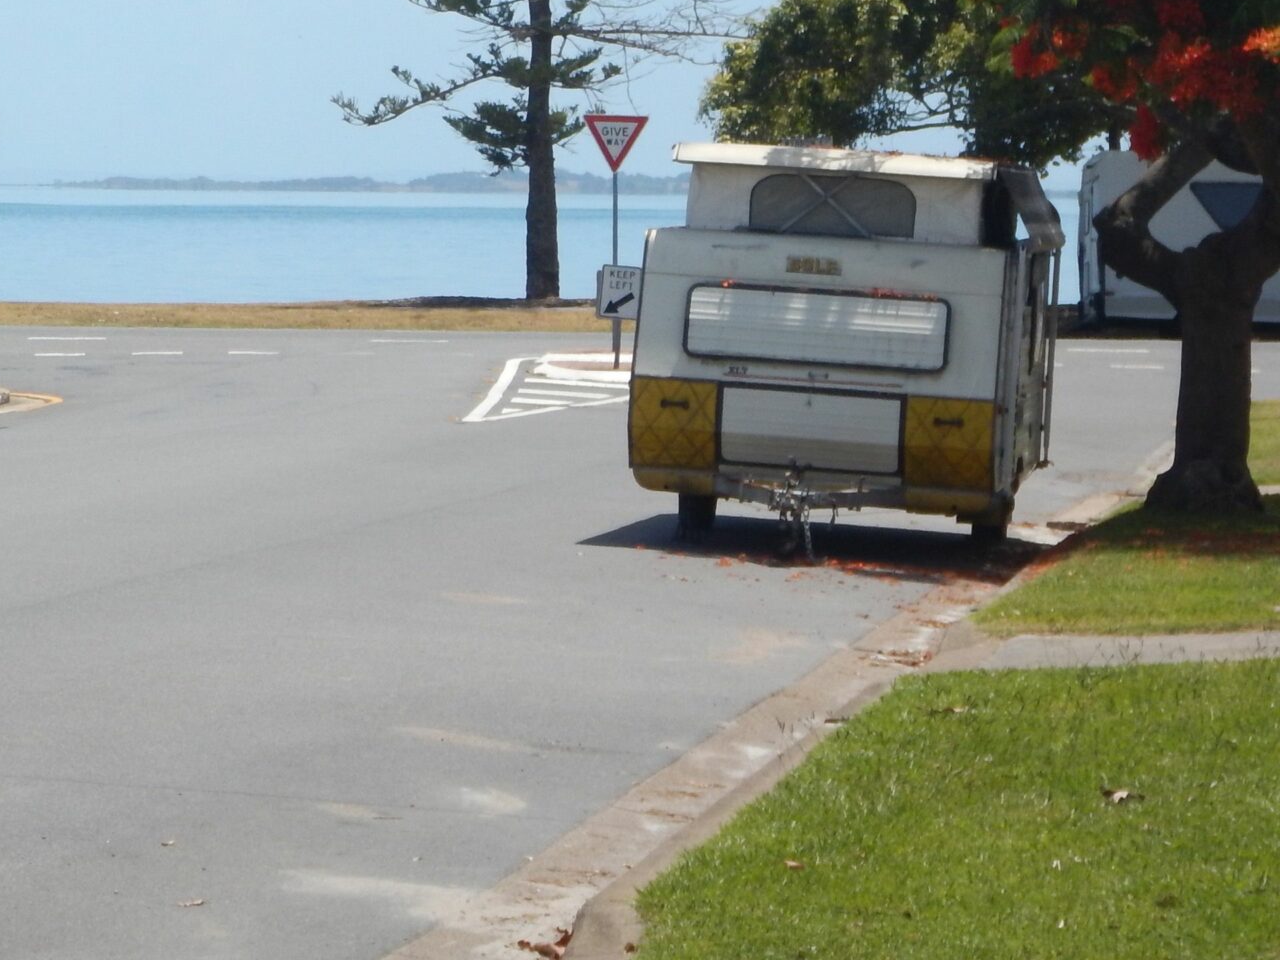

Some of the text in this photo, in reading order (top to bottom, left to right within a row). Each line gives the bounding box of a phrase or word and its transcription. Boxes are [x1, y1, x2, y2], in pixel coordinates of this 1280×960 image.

[601, 126, 629, 137] GIVE
[606, 138, 626, 146] WAY
[609, 270, 636, 280] KEEP
[609, 280, 634, 291] LEFT
